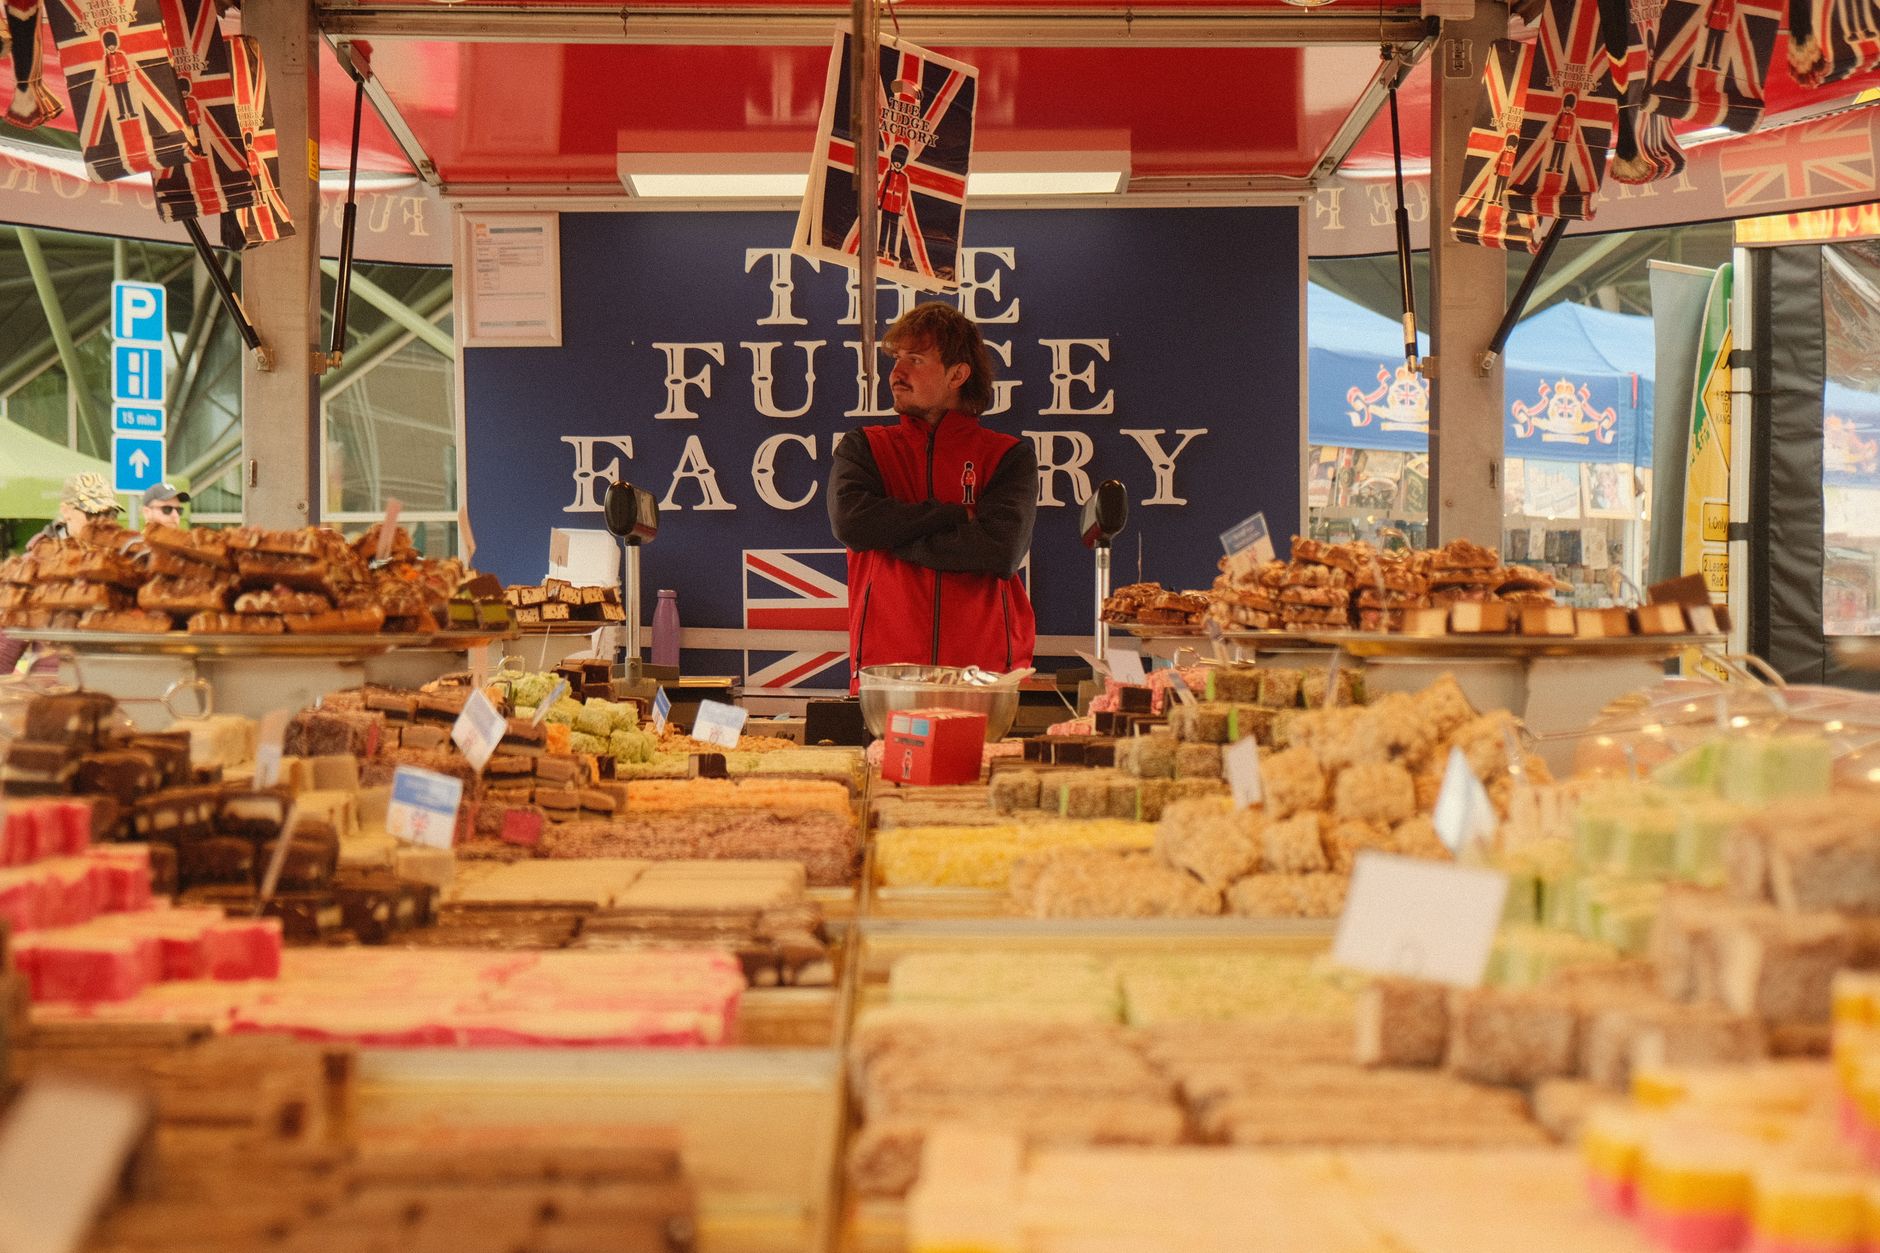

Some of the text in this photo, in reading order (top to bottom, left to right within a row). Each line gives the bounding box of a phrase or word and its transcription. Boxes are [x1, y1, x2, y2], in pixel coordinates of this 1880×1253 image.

[74, 11, 138, 32] FACTORY
[83, 5, 127, 20] FUDGE
[176, 55, 200, 65] DGE
[176, 61, 210, 72] TORY
[1564, 63, 1586, 73] THE
[1545, 76, 1602, 92] FACTORY
[1556, 70, 1593, 83] FUDGE
[888, 97, 921, 118] THE
[881, 107, 931, 133] FUDGE
[880, 120, 940, 148] ACTORY
[745, 247, 1020, 326] THE
[122, 287, 157, 338] P
[122, 411, 157, 426] 15 min
[560, 428, 1208, 513] FACRY
